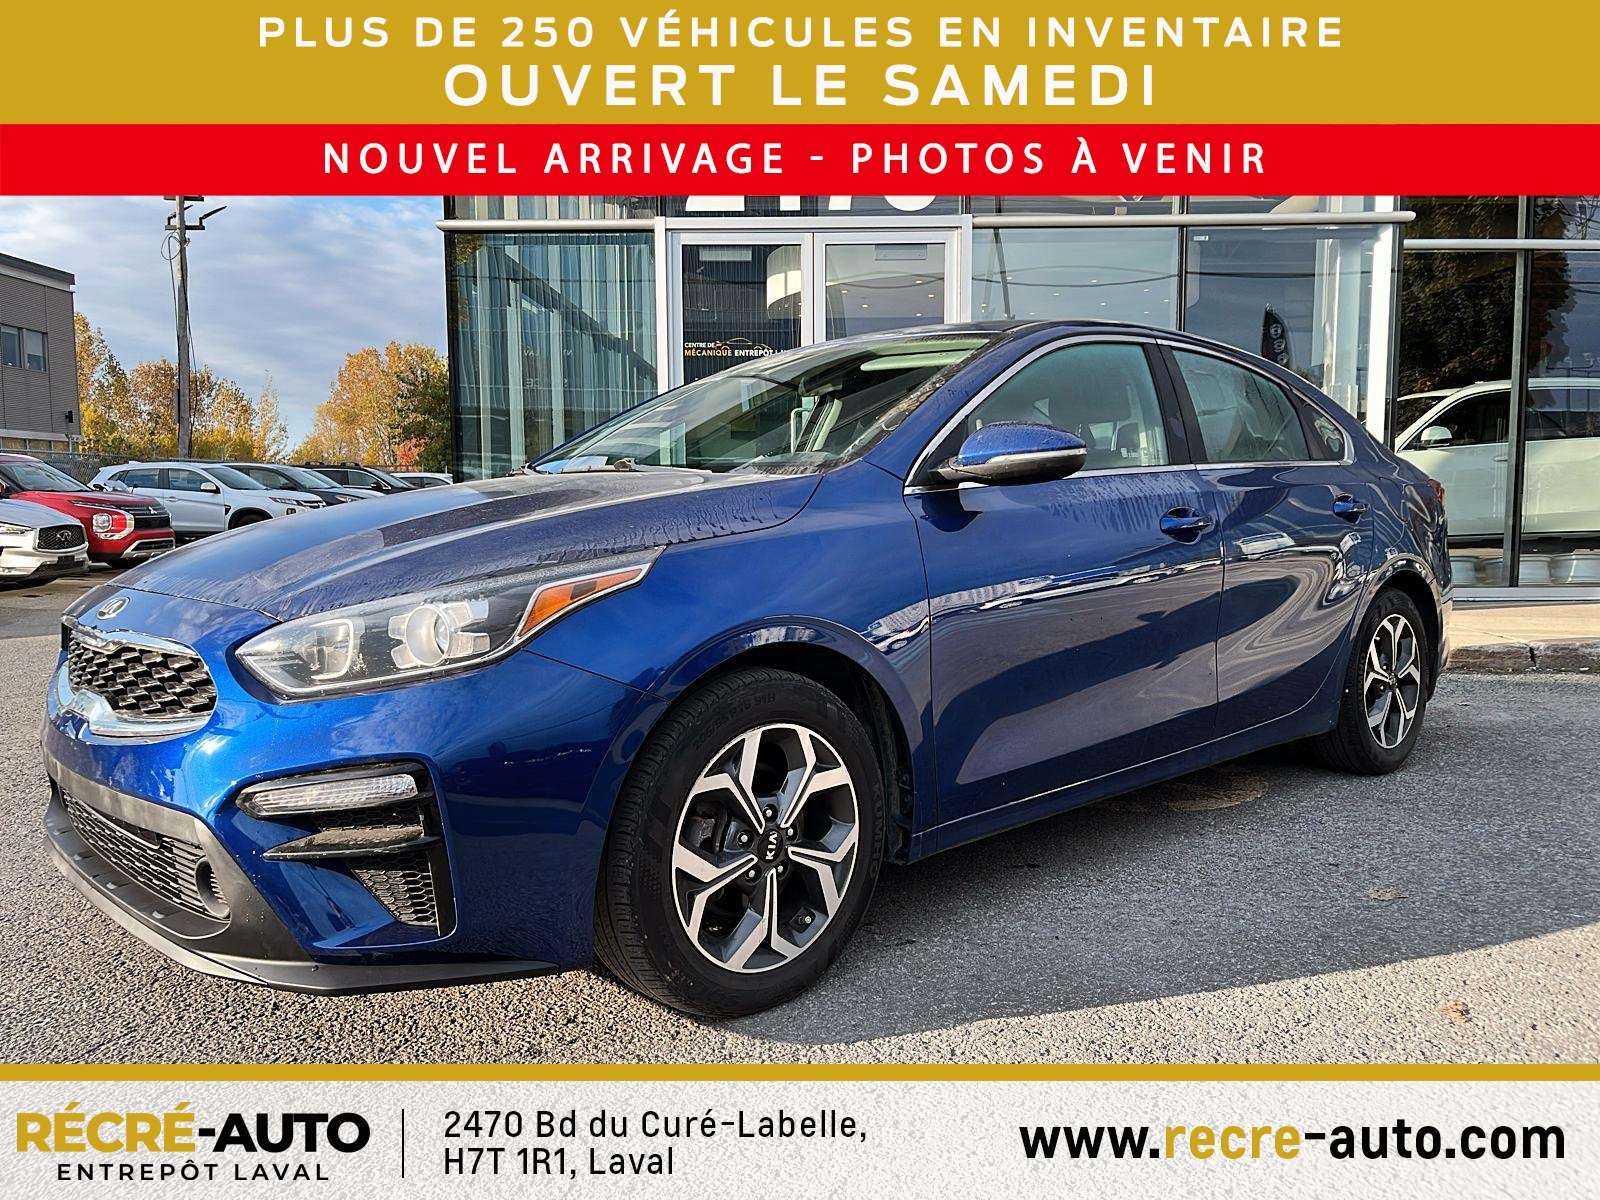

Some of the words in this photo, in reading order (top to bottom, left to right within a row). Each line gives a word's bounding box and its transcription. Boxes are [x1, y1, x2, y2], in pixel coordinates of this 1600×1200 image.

[684, 348, 732, 357] MÉCANIQUE
[734, 348, 773, 357] ENTREPÔT
[765, 831, 778, 860] KIA
